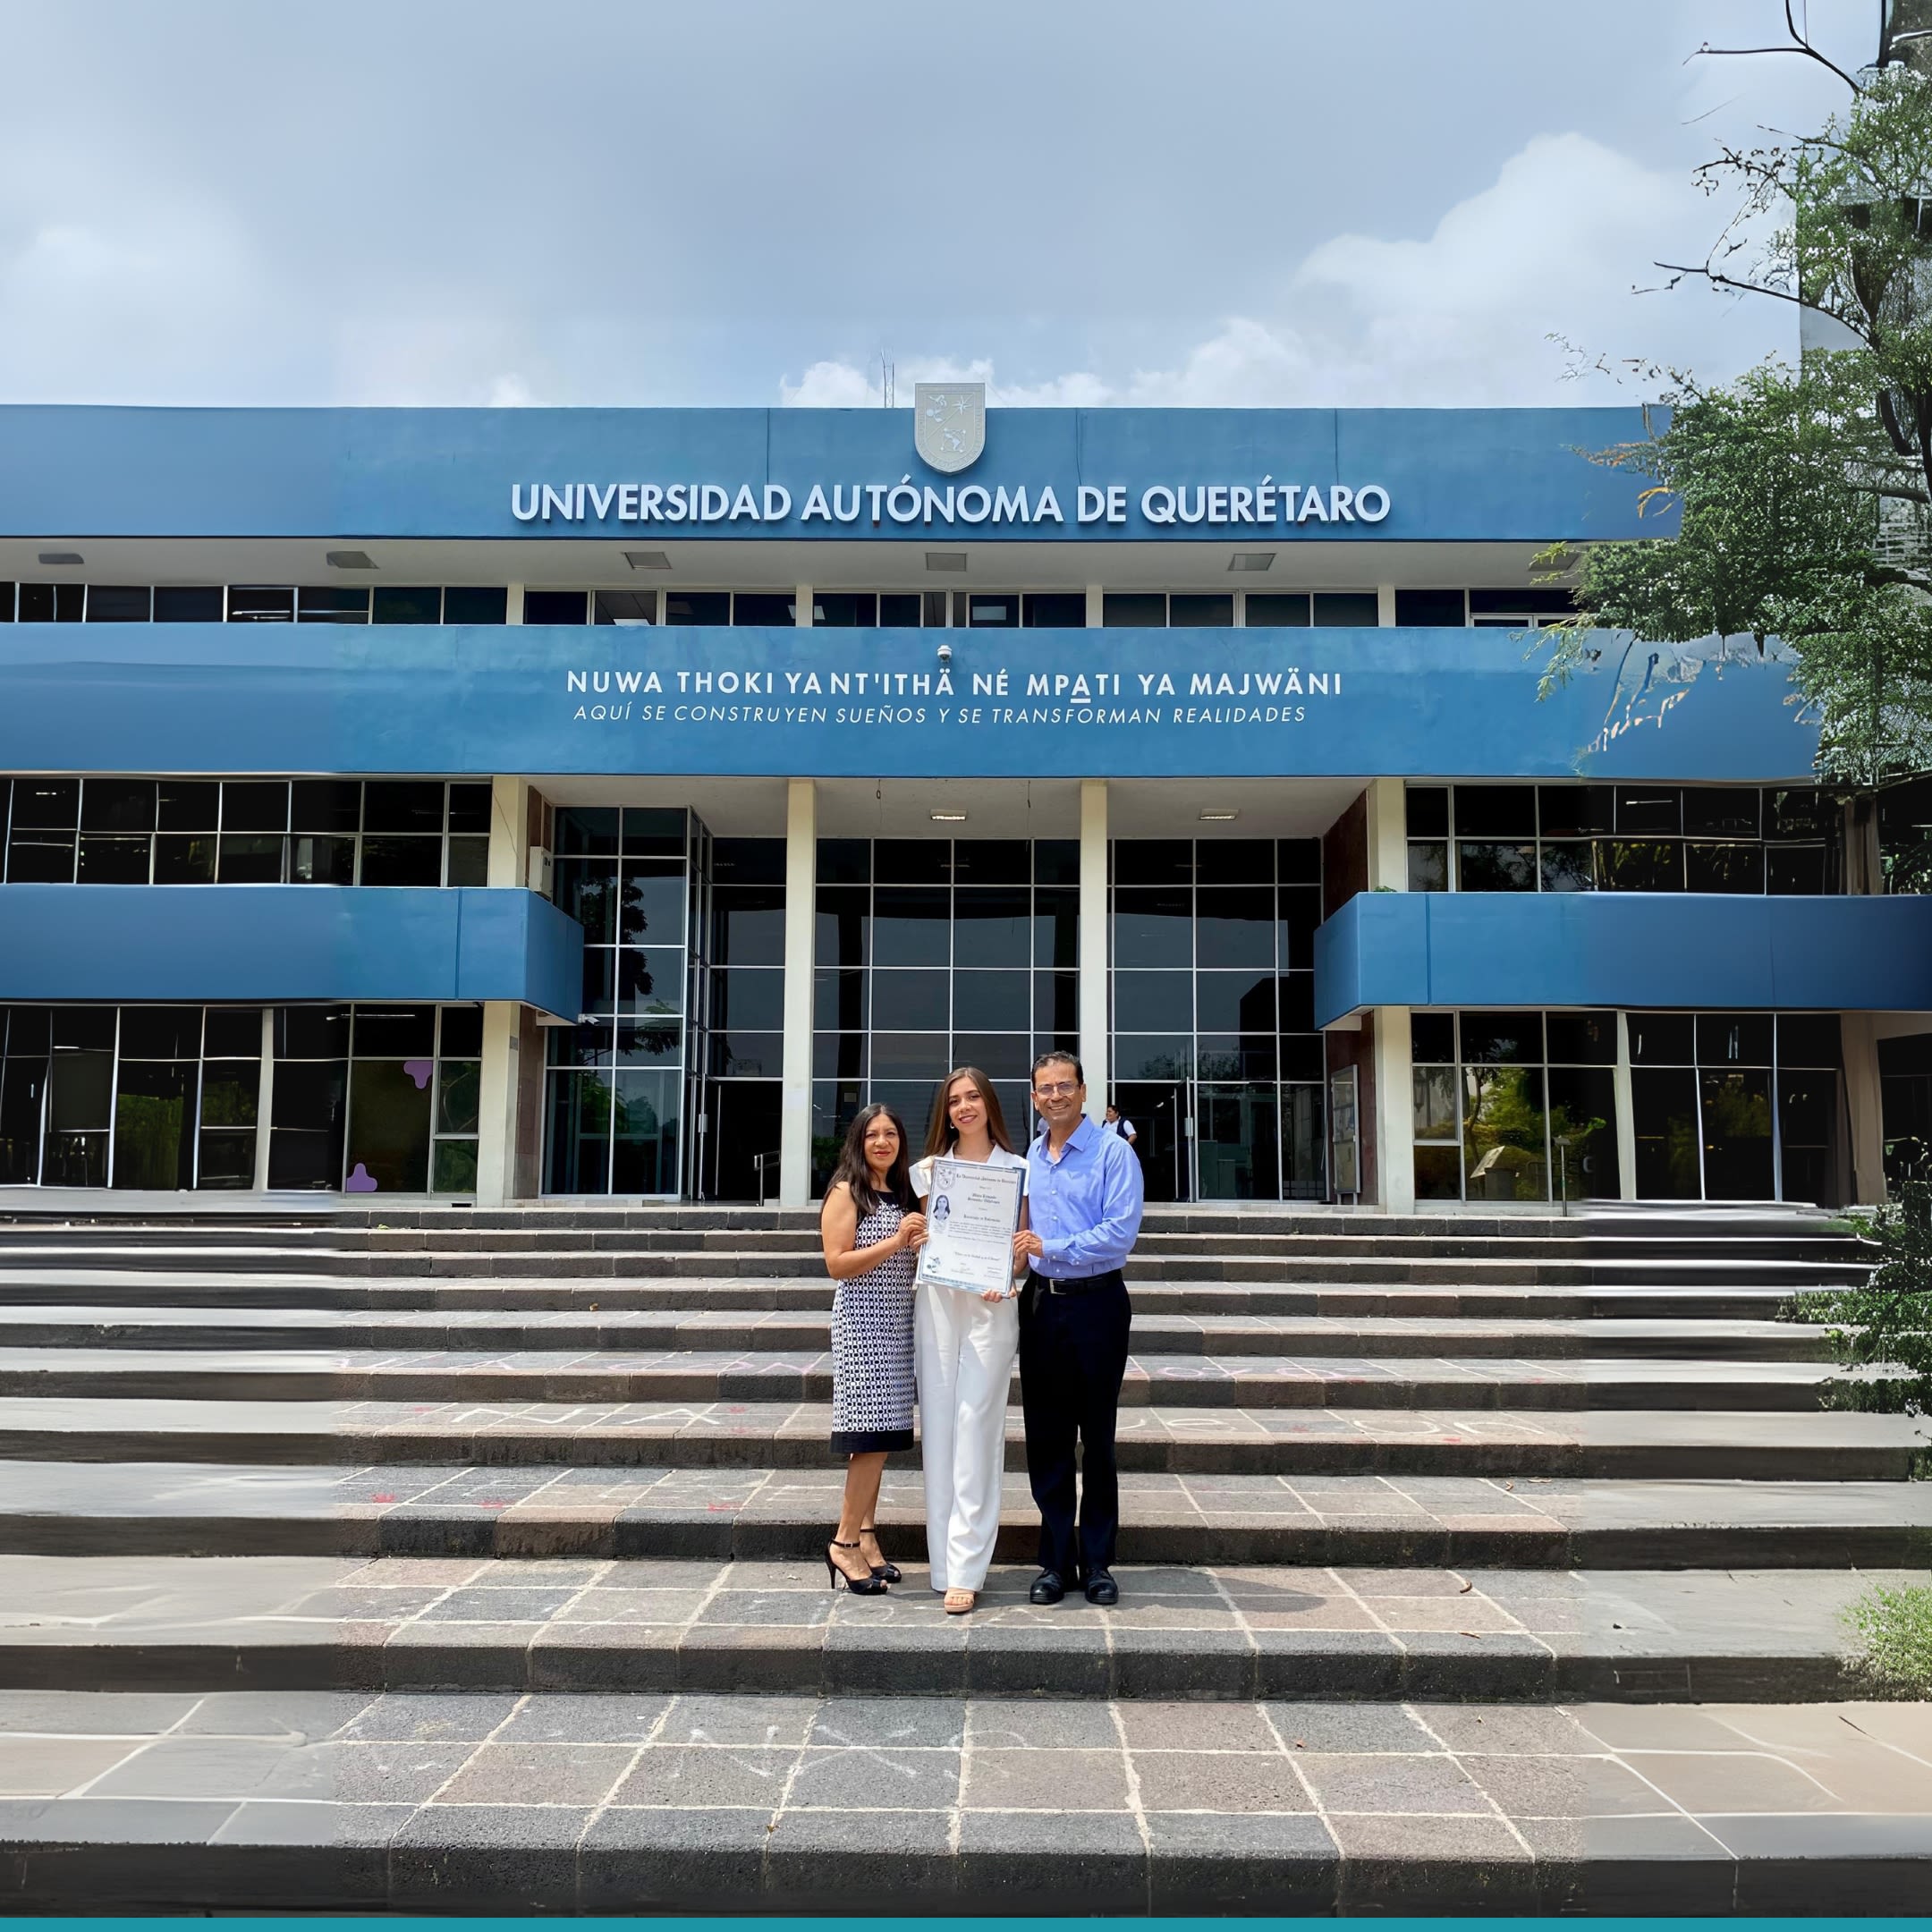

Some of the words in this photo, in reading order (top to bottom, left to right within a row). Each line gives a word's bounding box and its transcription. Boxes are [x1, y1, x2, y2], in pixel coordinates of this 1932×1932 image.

[512, 483, 793, 521] UNIVERSIDAD
[801, 473, 1064, 523] AUTÓNOMA
[1077, 485, 1128, 523] DE
[1141, 473, 1392, 524] QUERÉTARO
[567, 670, 664, 694] NUWA
[676, 671, 774, 695] THOKI
[972, 667, 1009, 697] NÉ
[1138, 673, 1176, 696] YA
[1190, 666, 1342, 696] MAJWÄNI
[573, 700, 632, 721] AQUÍ
[642, 705, 666, 721] SE
[674, 705, 827, 723] CONSTRUYEN
[835, 704, 927, 724] SUEÑOS
[939, 708, 950, 724] Y
[958, 708, 983, 724] SE
[992, 708, 1162, 724] TRANSFORMAN
[1173, 706, 1306, 724] REALIDADES
